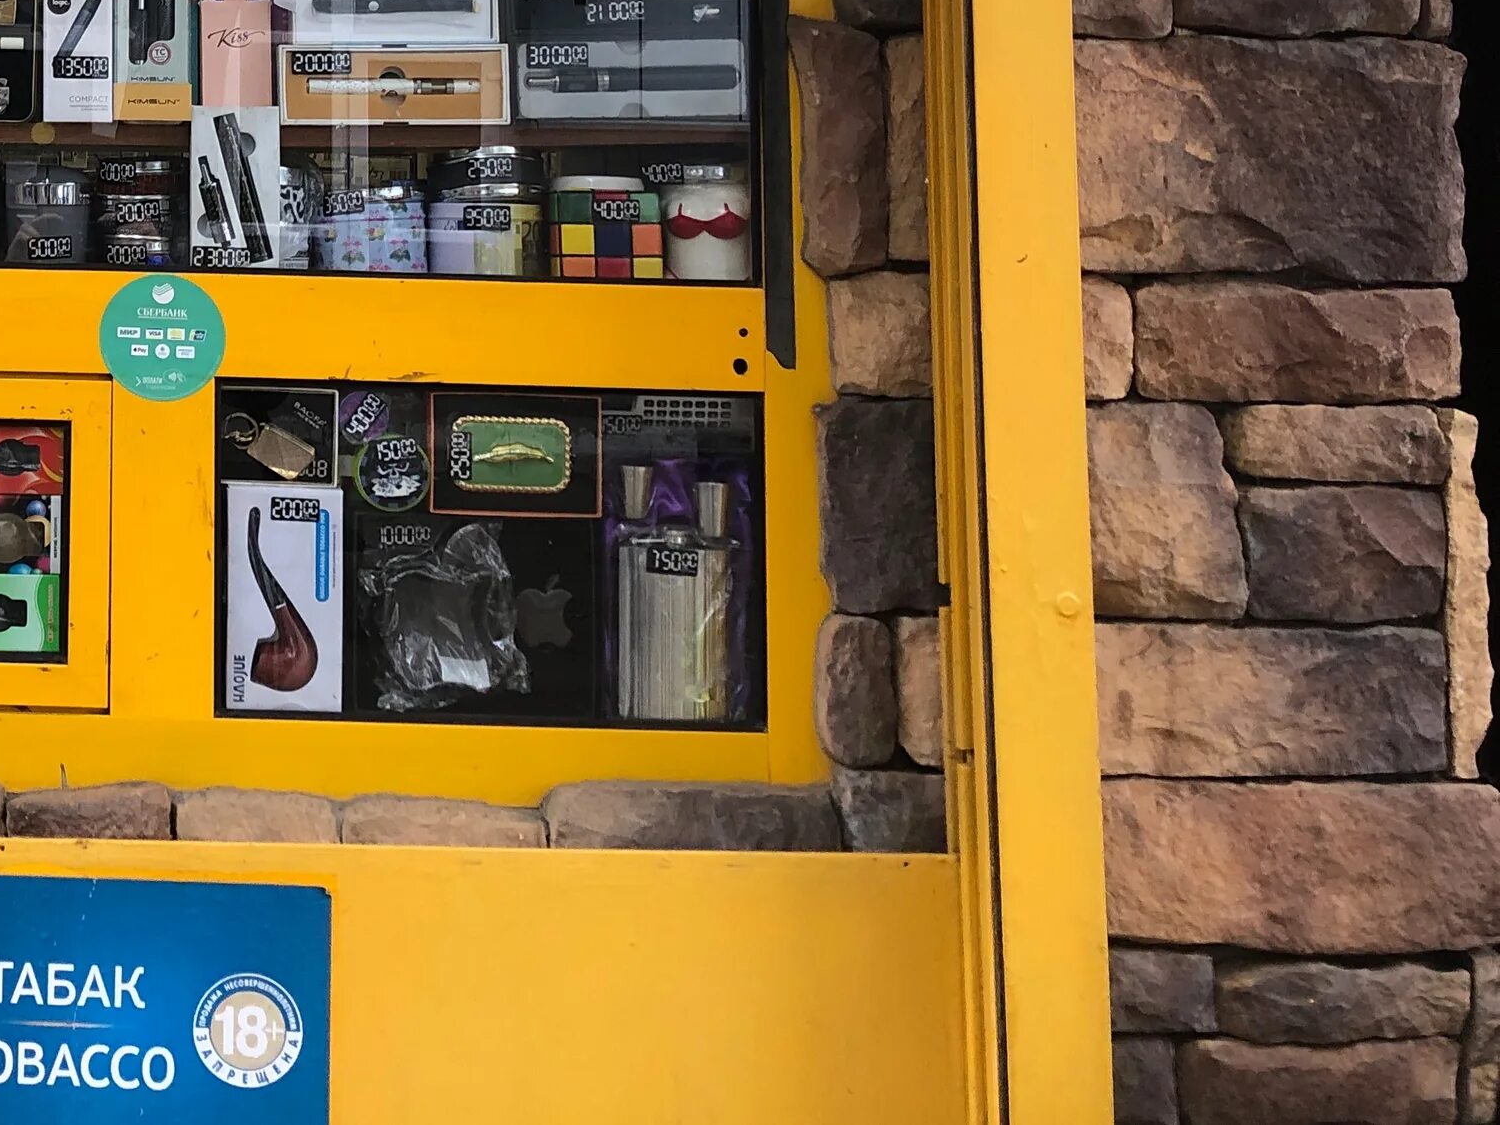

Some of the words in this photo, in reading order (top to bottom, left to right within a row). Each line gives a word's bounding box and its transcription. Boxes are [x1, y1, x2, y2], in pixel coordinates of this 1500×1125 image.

[207, 27, 266, 48] Kiss
[293, 54, 350, 72] 200000
[529, 46, 587, 65] 300000
[68, 95, 108, 103] COMPACT
[468, 157, 512, 178] 25000
[117, 202, 159, 222] 20000
[466, 208, 510, 227] 35000
[593, 200, 639, 220] 40000
[29, 238, 71, 258] 50000
[107, 245, 146, 264] 20000
[137, 307, 188, 318] СБЕРБАНК
[346, 393, 381, 434] 40000
[377, 437, 416, 461] 15000
[451, 432, 470, 480] 25000
[271, 499, 319, 519] 20000
[652, 549, 698, 572] 75000
[232, 653, 246, 703] HAOJUE
[198, 989, 223, 1027] ПРОДАЖА
[214, 1005, 286, 1059] 18+
[196, 1034, 299, 1084] ЗАПРЕЩЕНА
